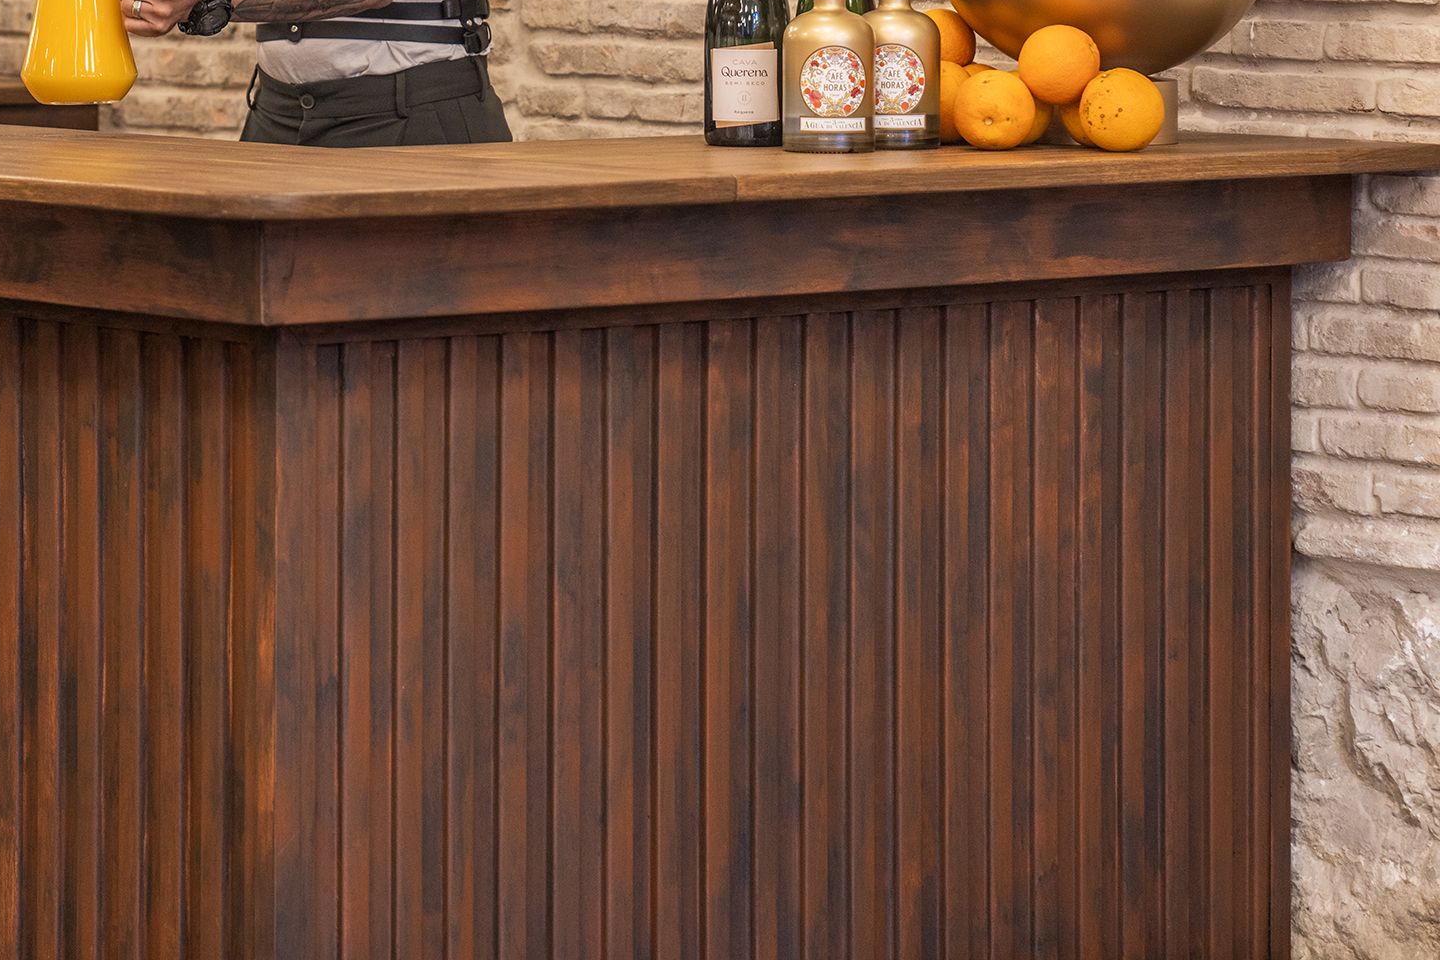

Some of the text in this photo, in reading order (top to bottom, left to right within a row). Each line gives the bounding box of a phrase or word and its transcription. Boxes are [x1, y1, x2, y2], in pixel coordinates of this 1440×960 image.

[721, 66, 768, 78] Querena
[881, 81, 904, 89] HORAS
[804, 121, 824, 129] AGUA
[835, 121, 863, 129] VALENCIA
[893, 118, 922, 126] VALENCIA
